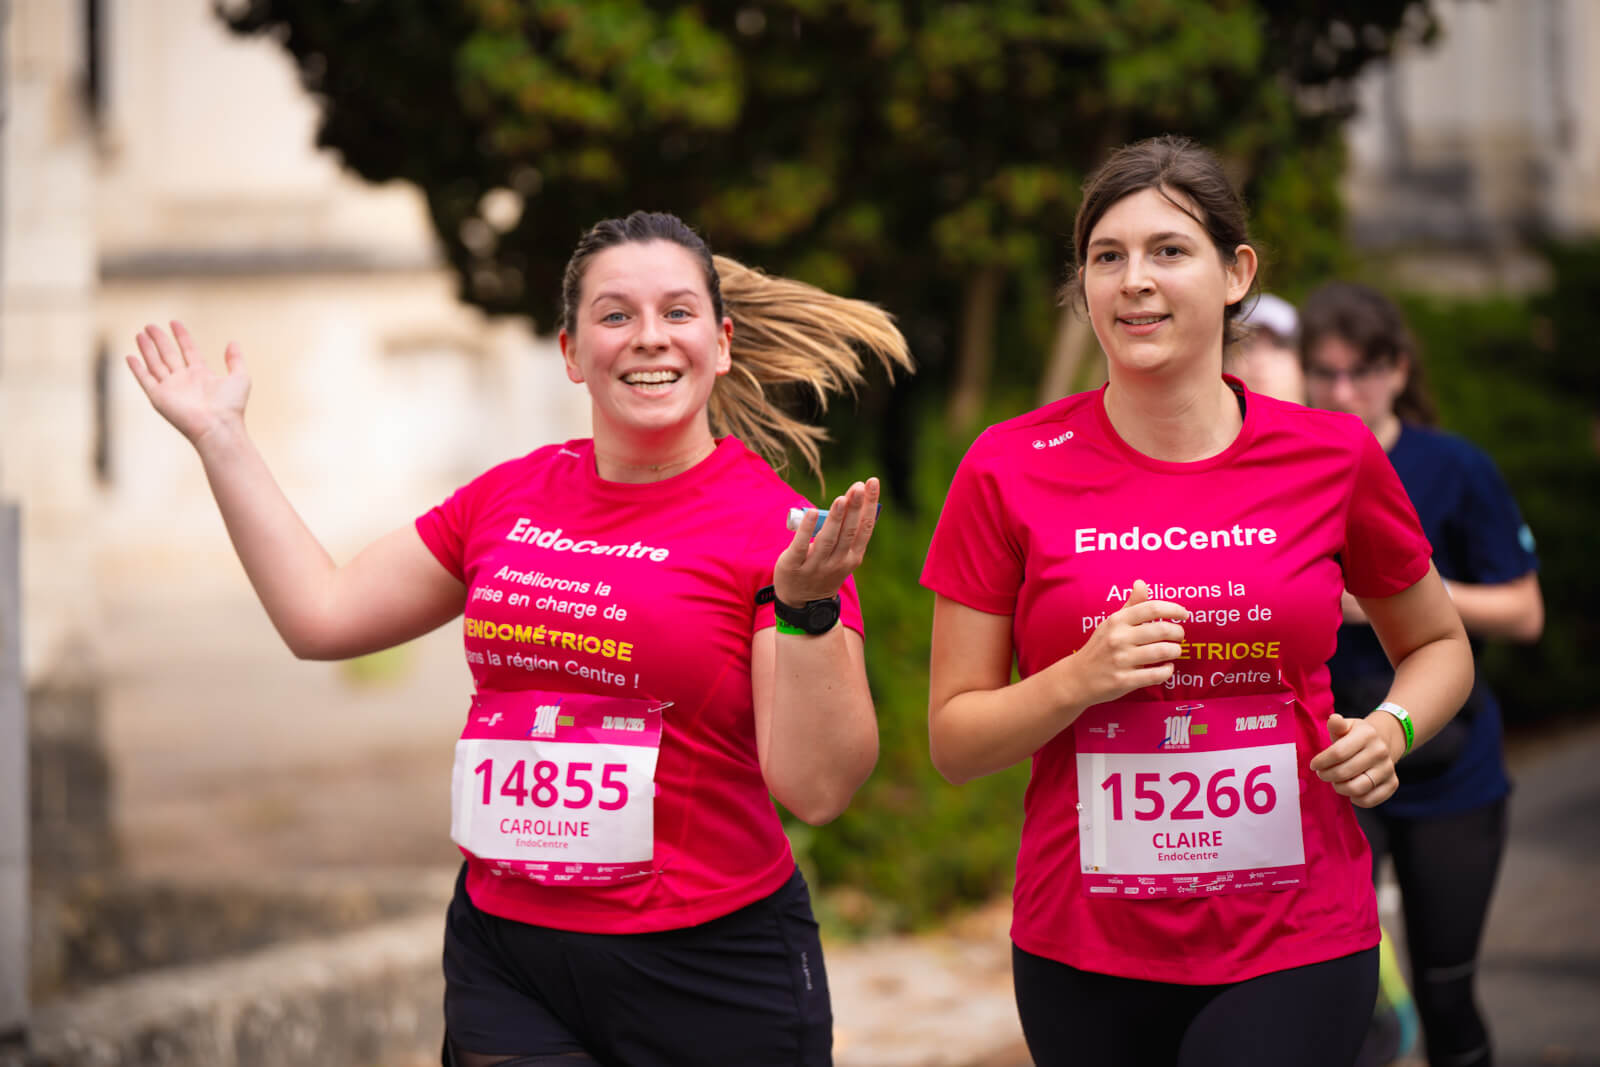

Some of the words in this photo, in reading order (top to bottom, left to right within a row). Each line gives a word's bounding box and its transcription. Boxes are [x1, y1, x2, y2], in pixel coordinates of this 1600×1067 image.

[1048, 430, 1074, 447] JAKO
[506, 517, 670, 562] EndoCentre
[1075, 524, 1278, 554] EndoCentre
[494, 565, 590, 595] Améliorons
[594, 581, 612, 597] la
[1228, 580, 1246, 597] la
[472, 585, 503, 603] prise
[508, 593, 530, 608] en
[536, 595, 597, 620] charge
[603, 604, 628, 622] de
[1082, 610, 1110, 633] pri
[1247, 604, 1273, 622] de
[487, 649, 502, 666] la
[507, 652, 559, 672] région
[565, 660, 626, 687] Centre
[633, 673, 640, 689] !
[1164, 670, 1204, 689] gion
[1210, 669, 1272, 687] Centre
[1277, 669, 1283, 685] !
[1164, 715, 1192, 745] 10K
[474, 758, 629, 811] 14855
[1101, 764, 1277, 821] 15266
[500, 818, 590, 837] CAROLINE
[1152, 830, 1223, 849] CLAIRE
[515, 838, 569, 849] EndoCentre
[1157, 850, 1219, 862] EndoCentre
